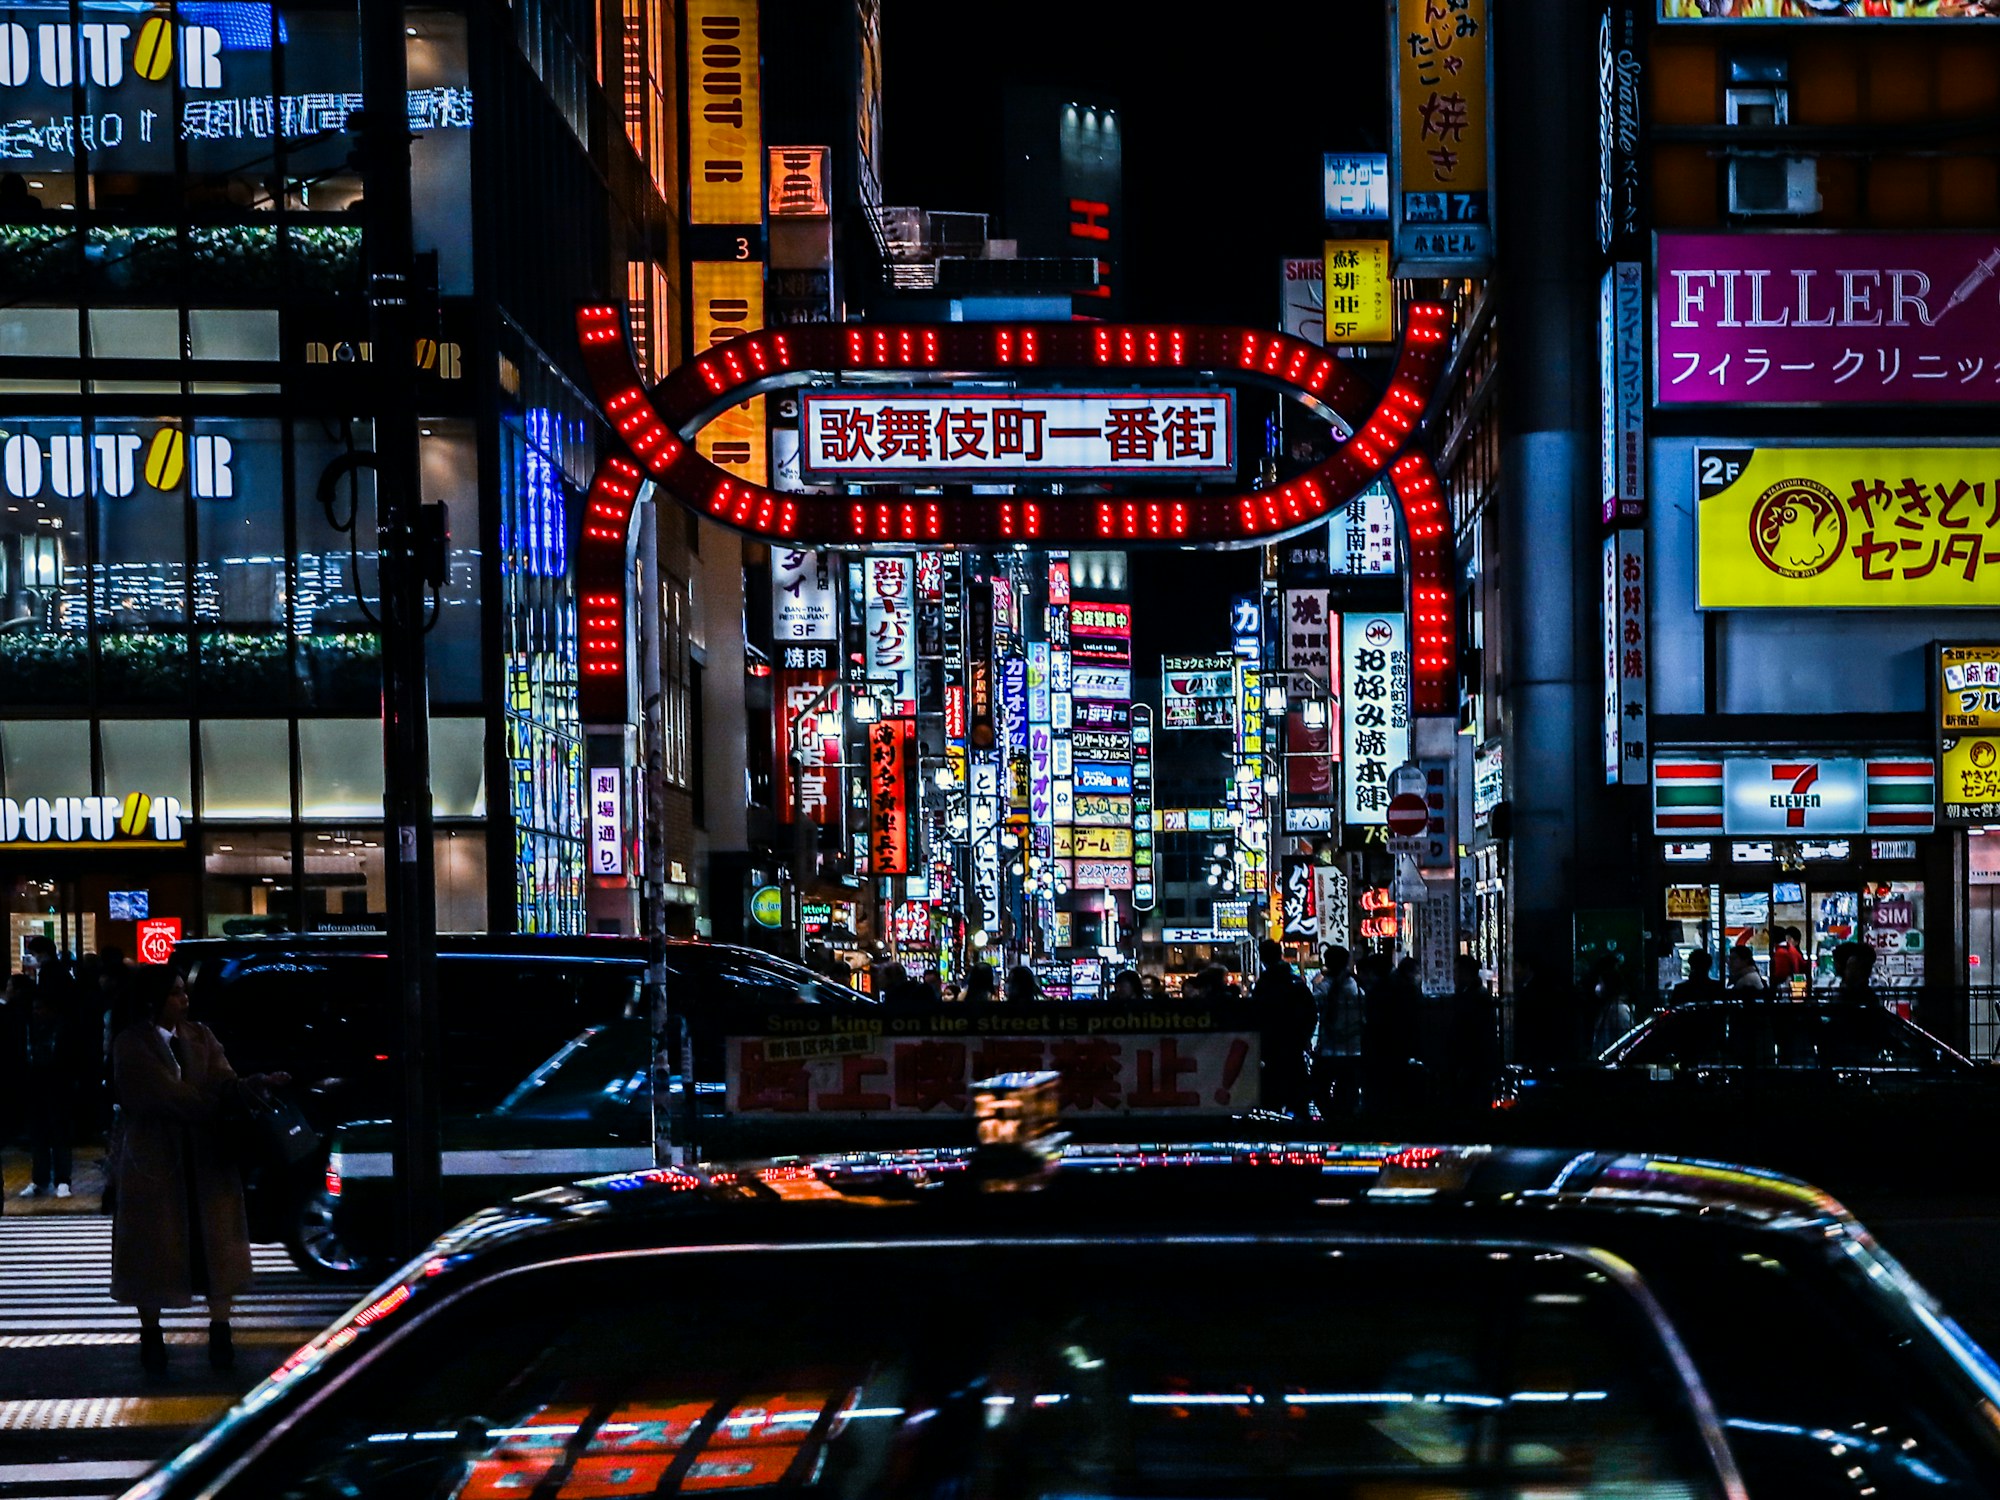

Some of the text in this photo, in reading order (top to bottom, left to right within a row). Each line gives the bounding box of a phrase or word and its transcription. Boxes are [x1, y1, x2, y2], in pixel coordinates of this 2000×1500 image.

[1407, 33, 1440, 84] たこ
[701, 16, 744, 183] DOUTOR
[1453, 194, 1478, 221] 7F
[736, 238, 749, 259] 3
[1670, 269, 1935, 328] FILLER
[1334, 322, 1357, 337] 5F
[1672, 349, 1815, 385] フィラー
[819, 406, 1216, 462] 歌舞伎町一番街
[1701, 457, 1740, 485] 2F
[779, 613, 830, 621] RESTAURANT
[793, 624, 816, 636] 3F
[784, 646, 826, 668] 焼肉
[1965, 664, 1999, 683] 麻雀
[1006, 658, 1025, 731] カラオケ
[1032, 729, 1049, 818] カラオケ
[1771, 764, 1818, 827] 7
[597, 776, 616, 870] 劇場通り
[1075, 837, 1111, 852] ゲーム
[1877, 907, 1909, 923] SIM
[148, 939, 167, 953] 40
[831, 1014, 884, 1036] king
[891, 1017, 921, 1032] on
[930, 1015, 969, 1032] the
[977, 1014, 1050, 1031] street
[1058, 1014, 1079, 1031] is
